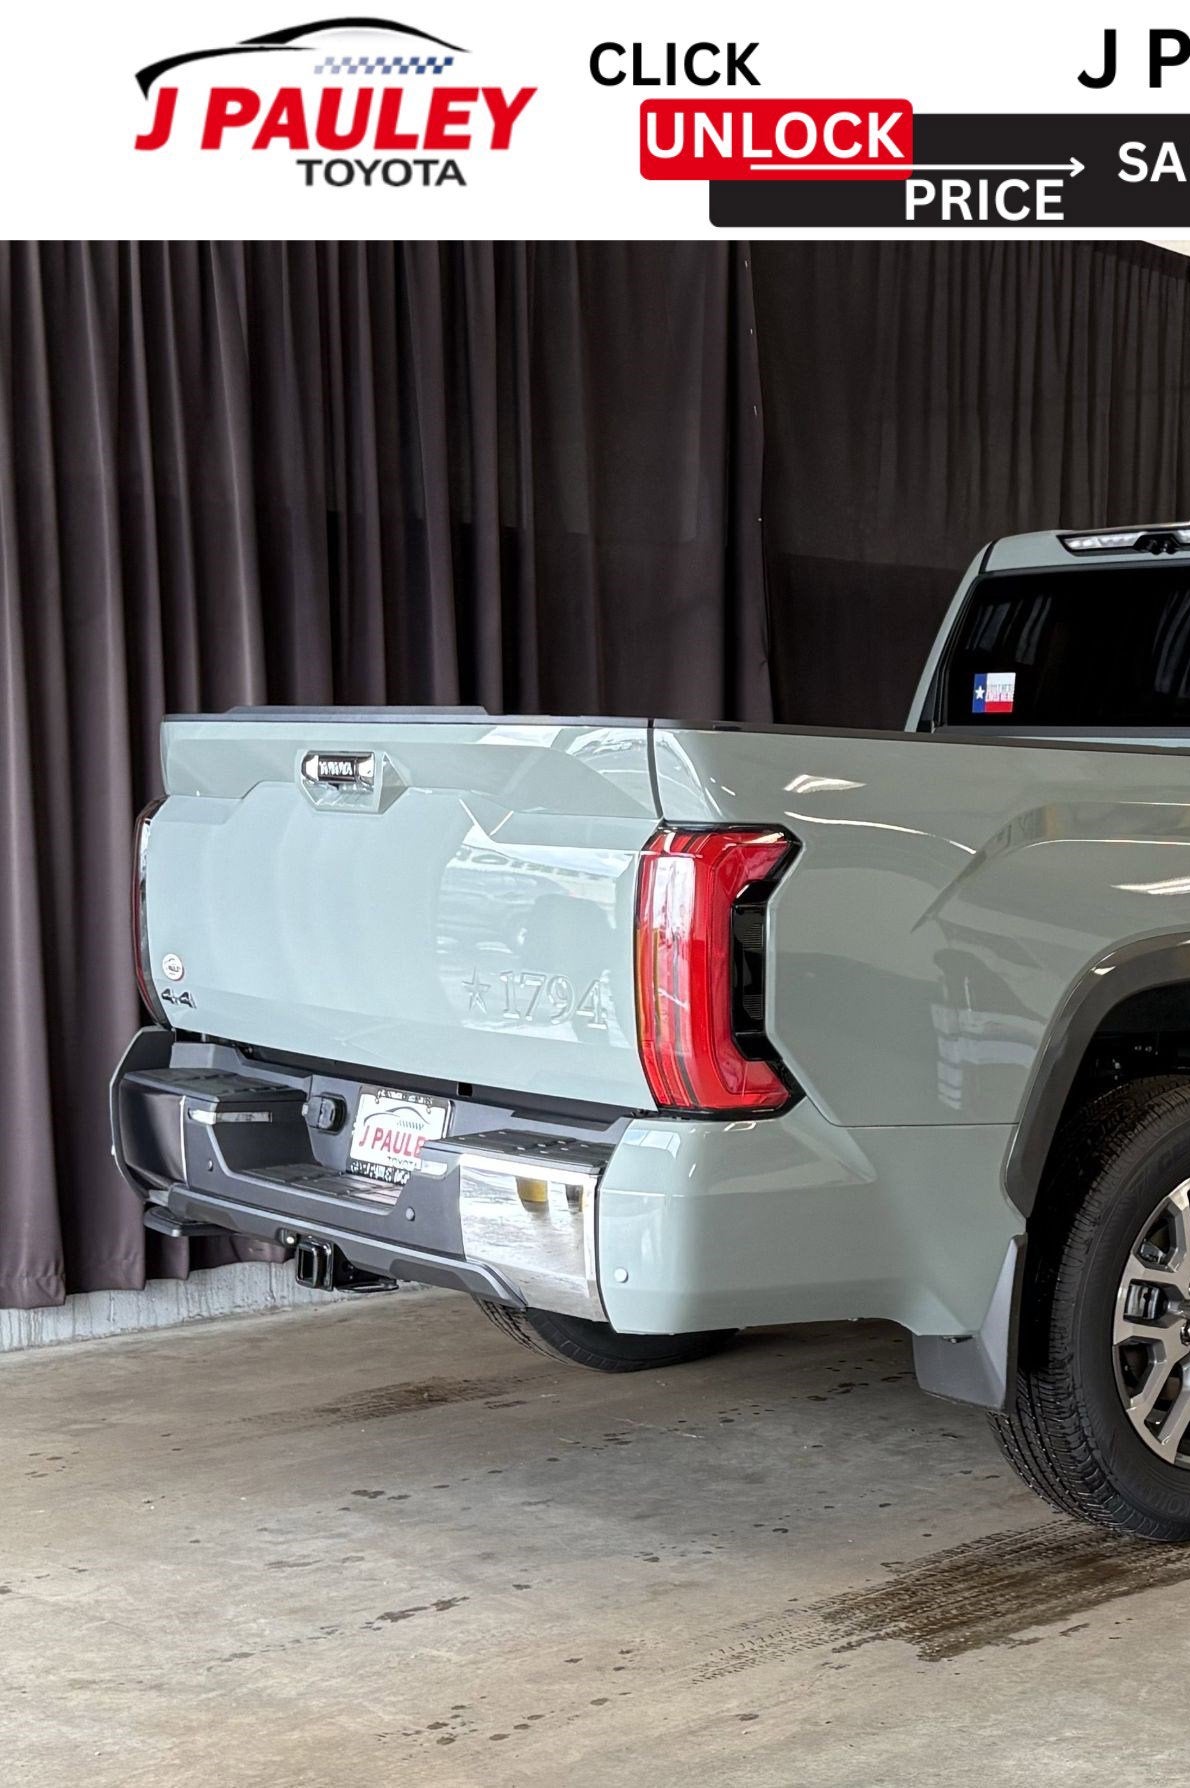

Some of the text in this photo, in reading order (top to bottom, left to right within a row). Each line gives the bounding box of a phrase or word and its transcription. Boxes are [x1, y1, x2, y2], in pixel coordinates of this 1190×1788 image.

[500, 970, 608, 1030] 1794
[358, 1124, 427, 1159] J PAULE
